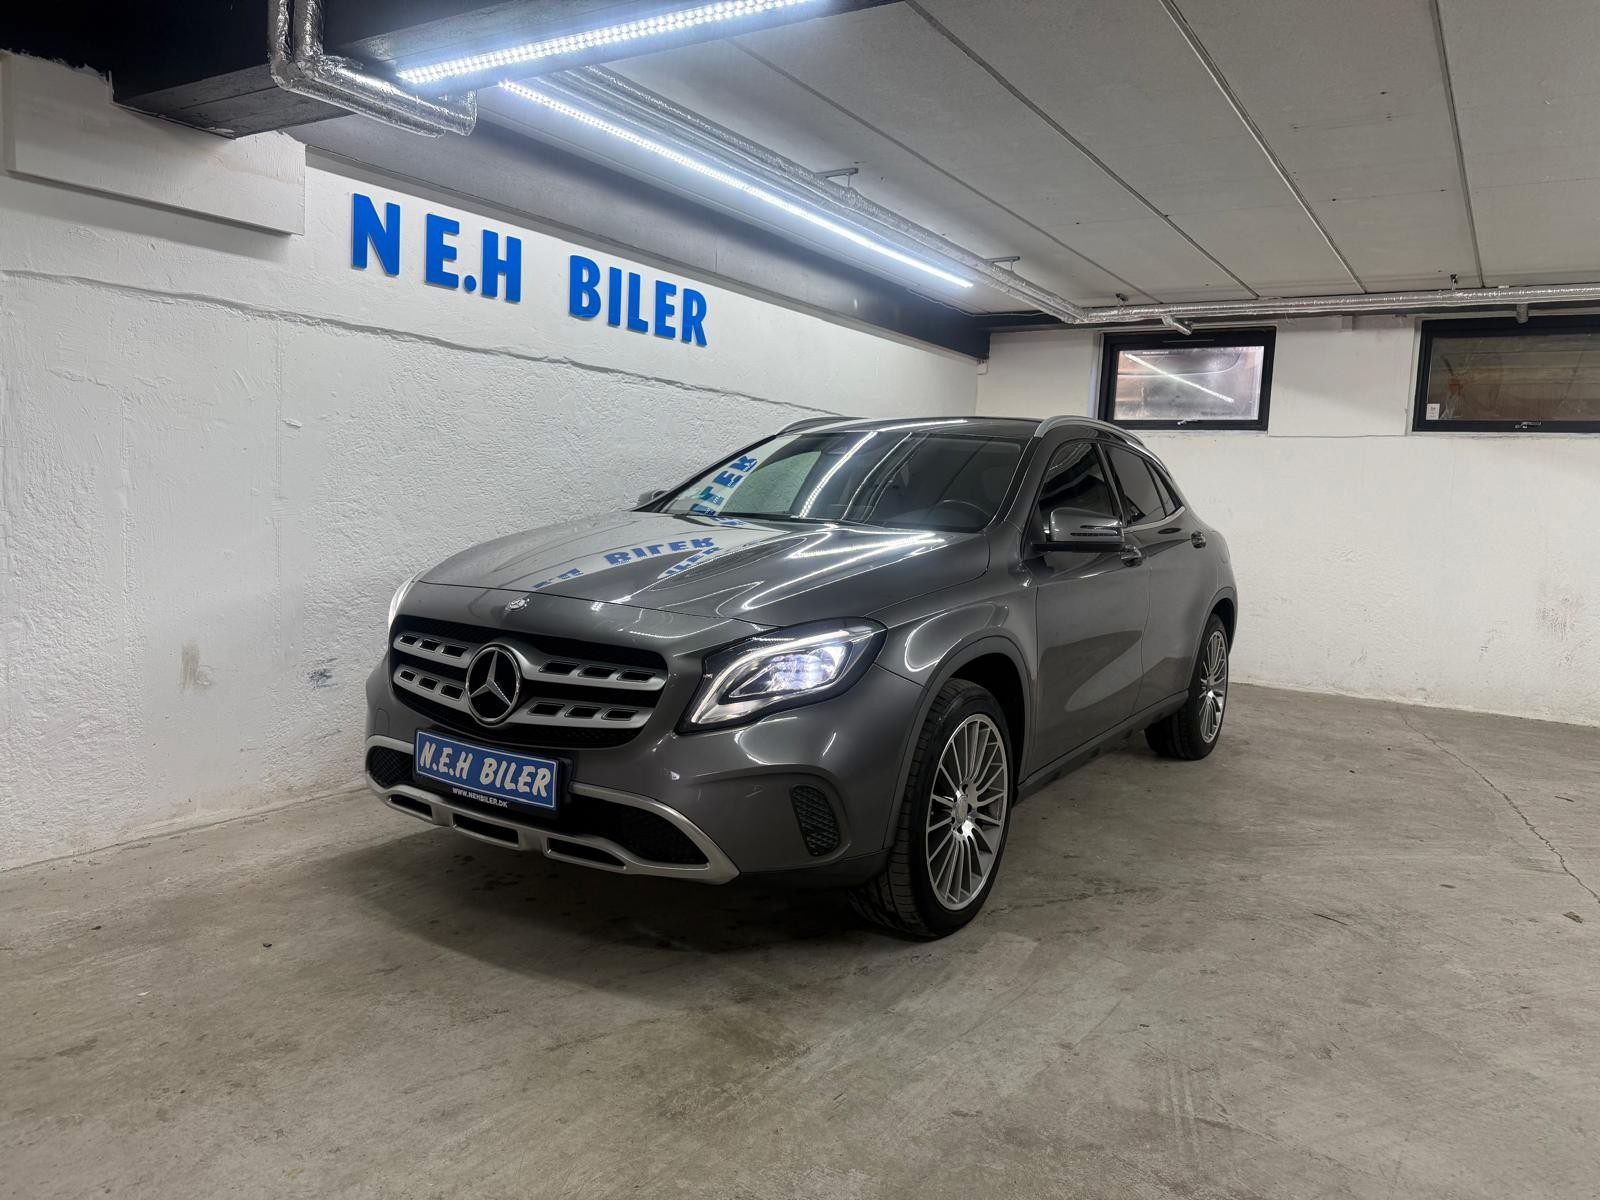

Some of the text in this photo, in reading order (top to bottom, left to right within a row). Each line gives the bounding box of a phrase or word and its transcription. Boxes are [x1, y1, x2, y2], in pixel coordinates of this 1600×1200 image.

[351, 192, 708, 347] N E.H BILER
[419, 741, 552, 798] N.E.H BILER
